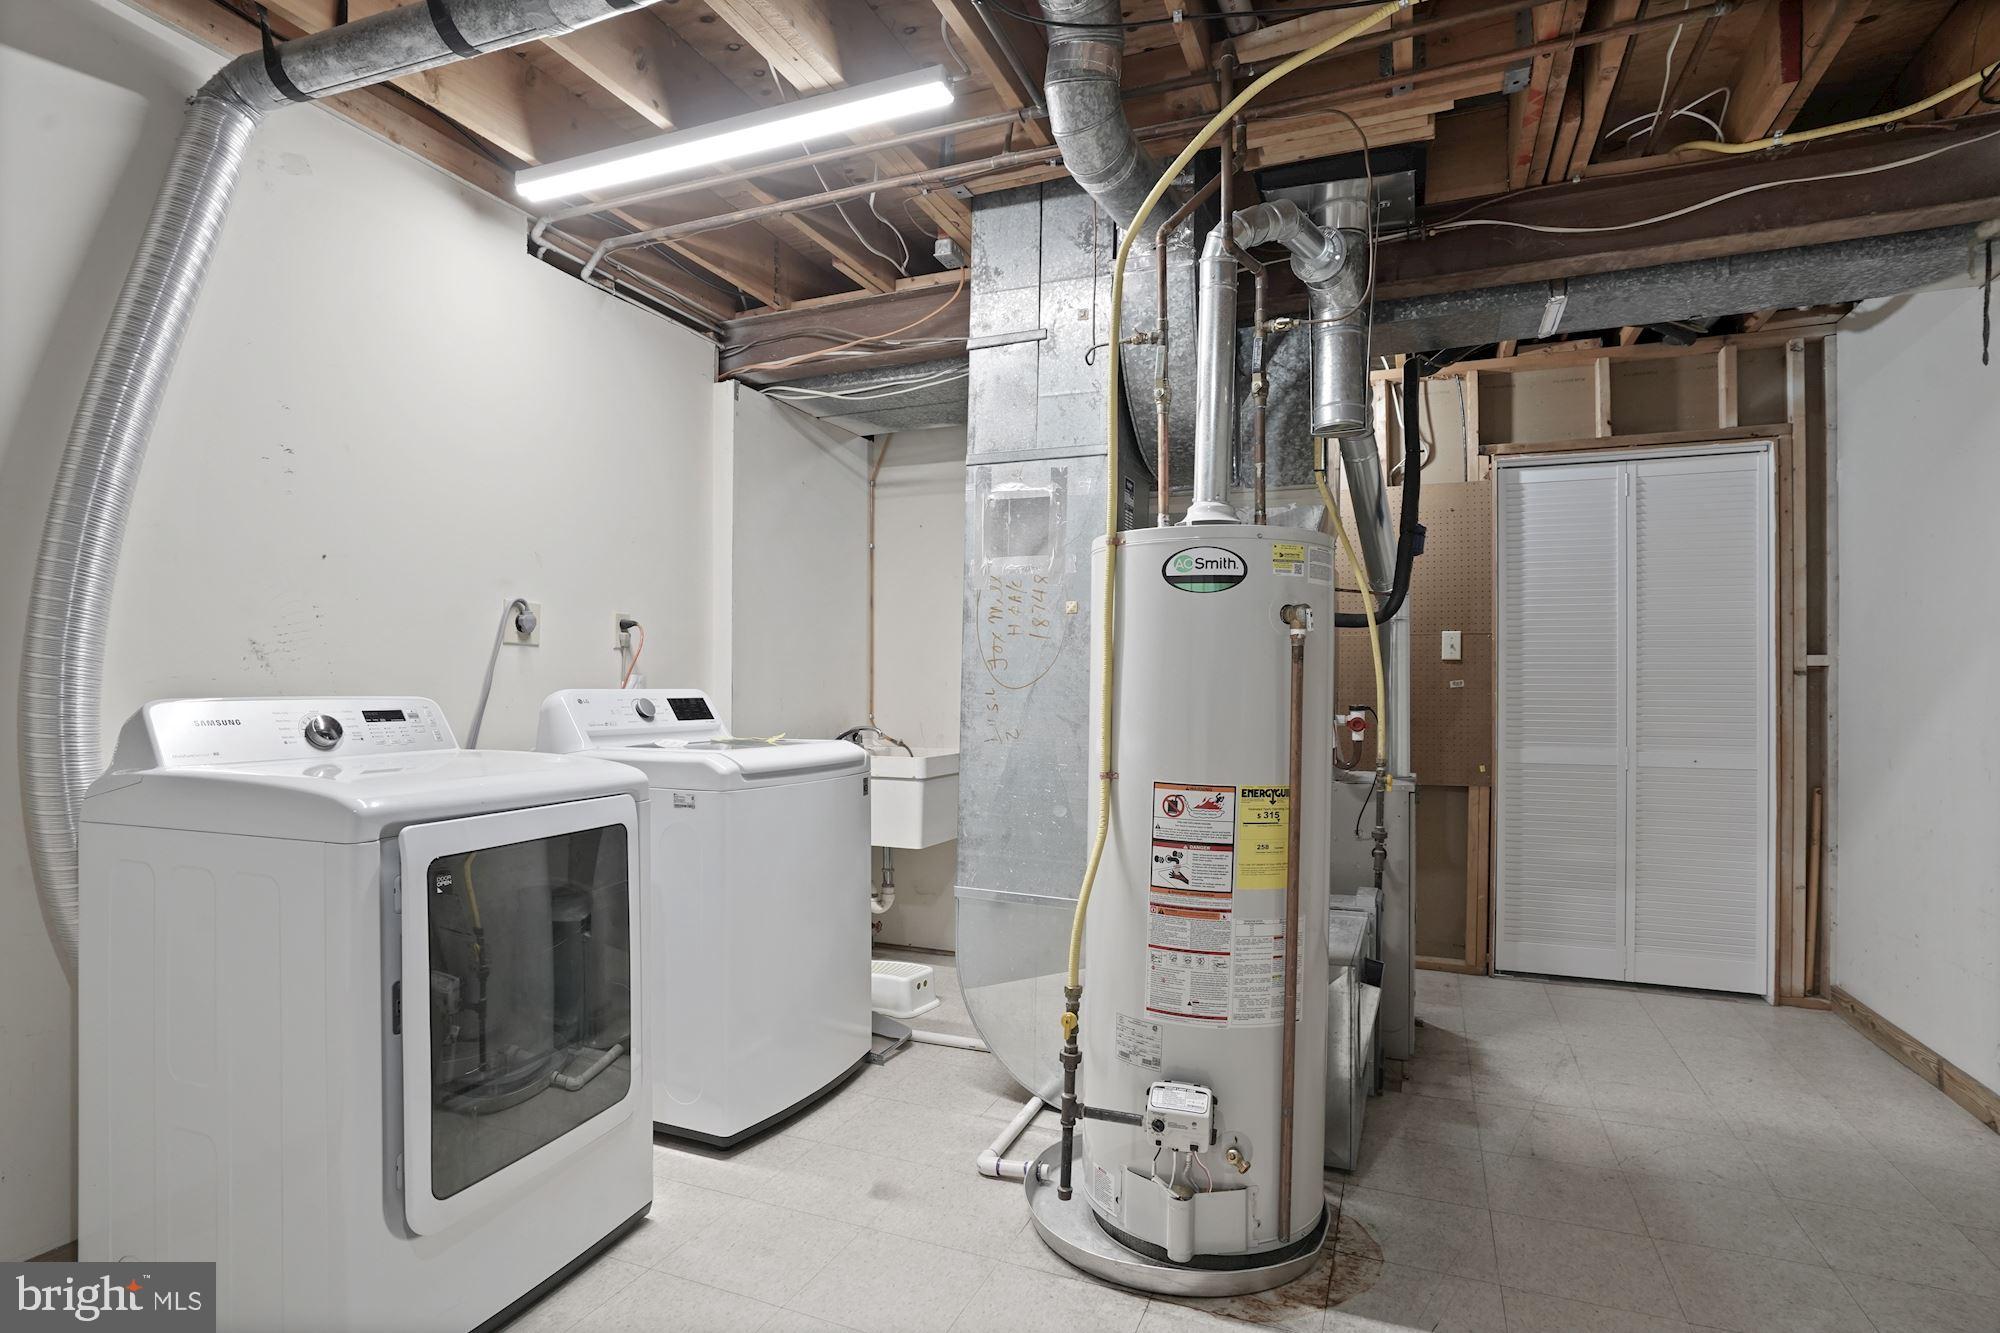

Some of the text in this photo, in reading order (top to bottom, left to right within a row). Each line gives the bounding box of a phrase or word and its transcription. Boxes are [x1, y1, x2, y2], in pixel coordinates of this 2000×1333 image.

[193, 719, 242, 727] SAMSUNG
[1241, 788, 1290, 799] ENERGYGU
[1263, 811, 1280, 819] 315
